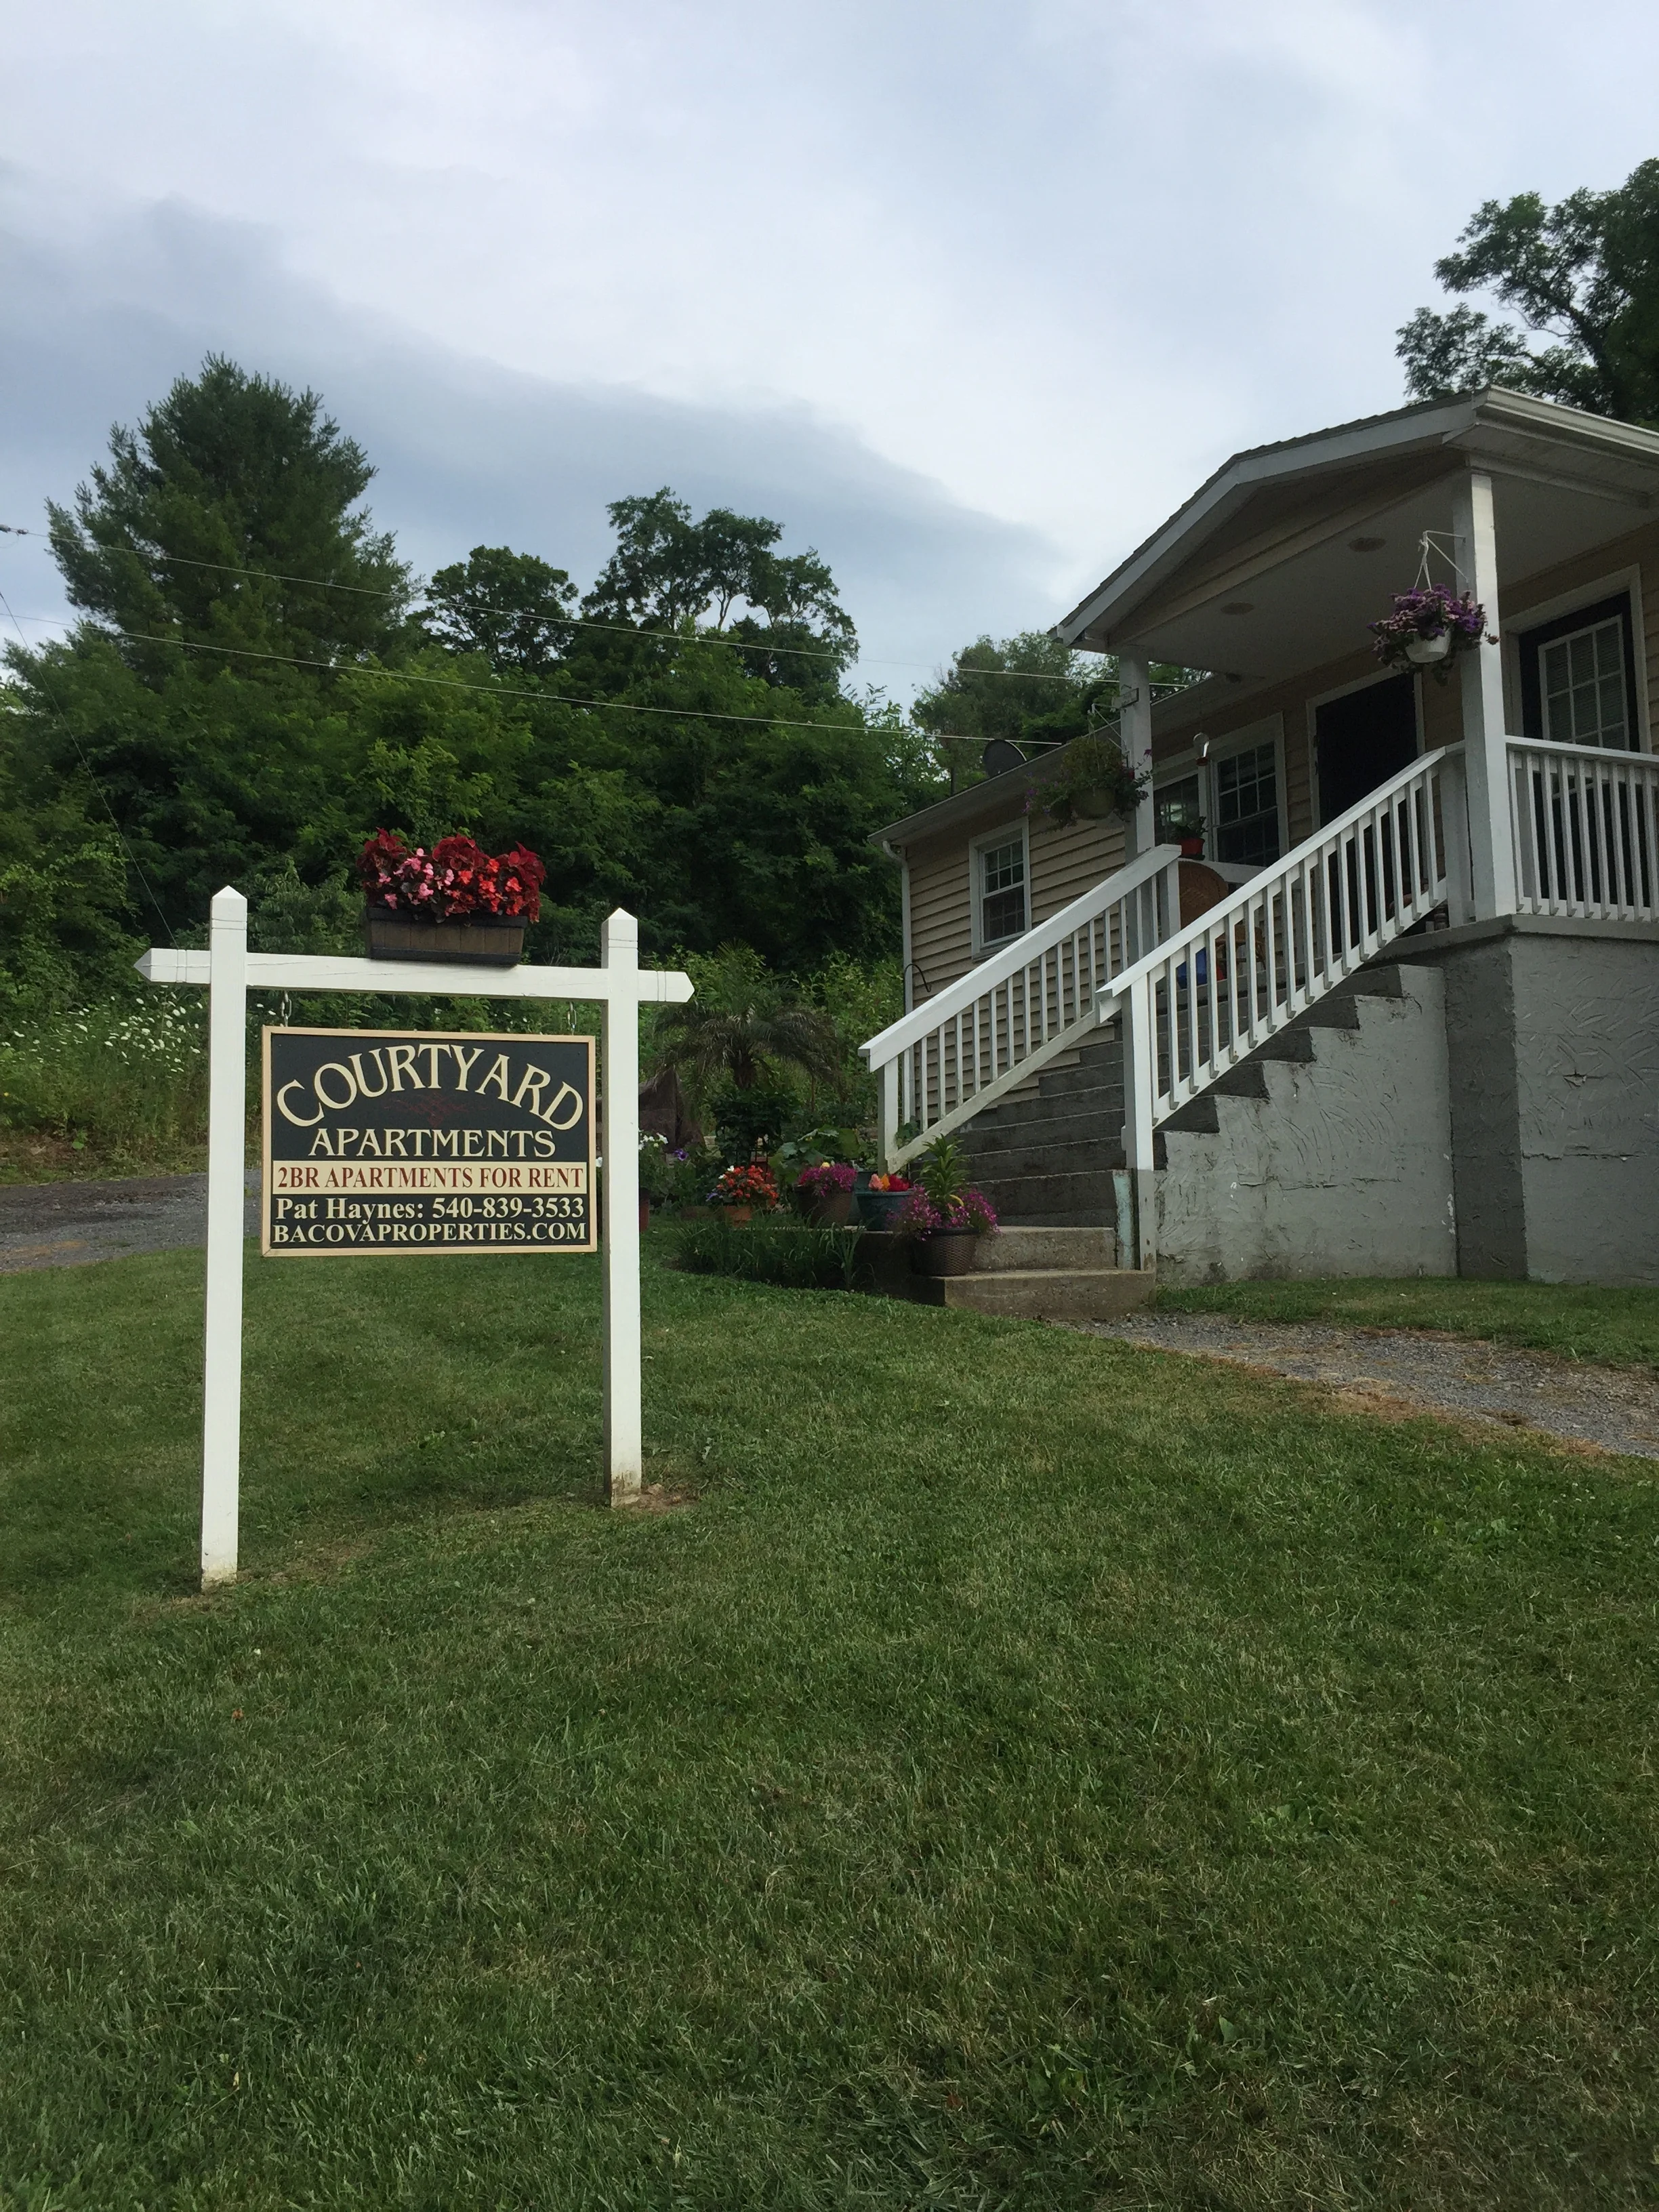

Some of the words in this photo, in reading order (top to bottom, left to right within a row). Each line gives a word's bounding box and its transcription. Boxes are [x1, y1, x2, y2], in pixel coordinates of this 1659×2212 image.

[276, 1043, 584, 1131] COURTYARD
[308, 1128, 556, 1158] APARTMENTS
[277, 1166, 321, 1189] 2BR
[325, 1166, 473, 1189] APARTMENTS
[478, 1166, 523, 1188] FOR
[528, 1167, 584, 1188] RENT
[276, 1197, 319, 1220] Pat
[325, 1197, 424, 1225] Haynes:
[431, 1196, 585, 1219] 540-839-3533
[272, 1222, 587, 1244] BACOVAPROPERTIES.COM
